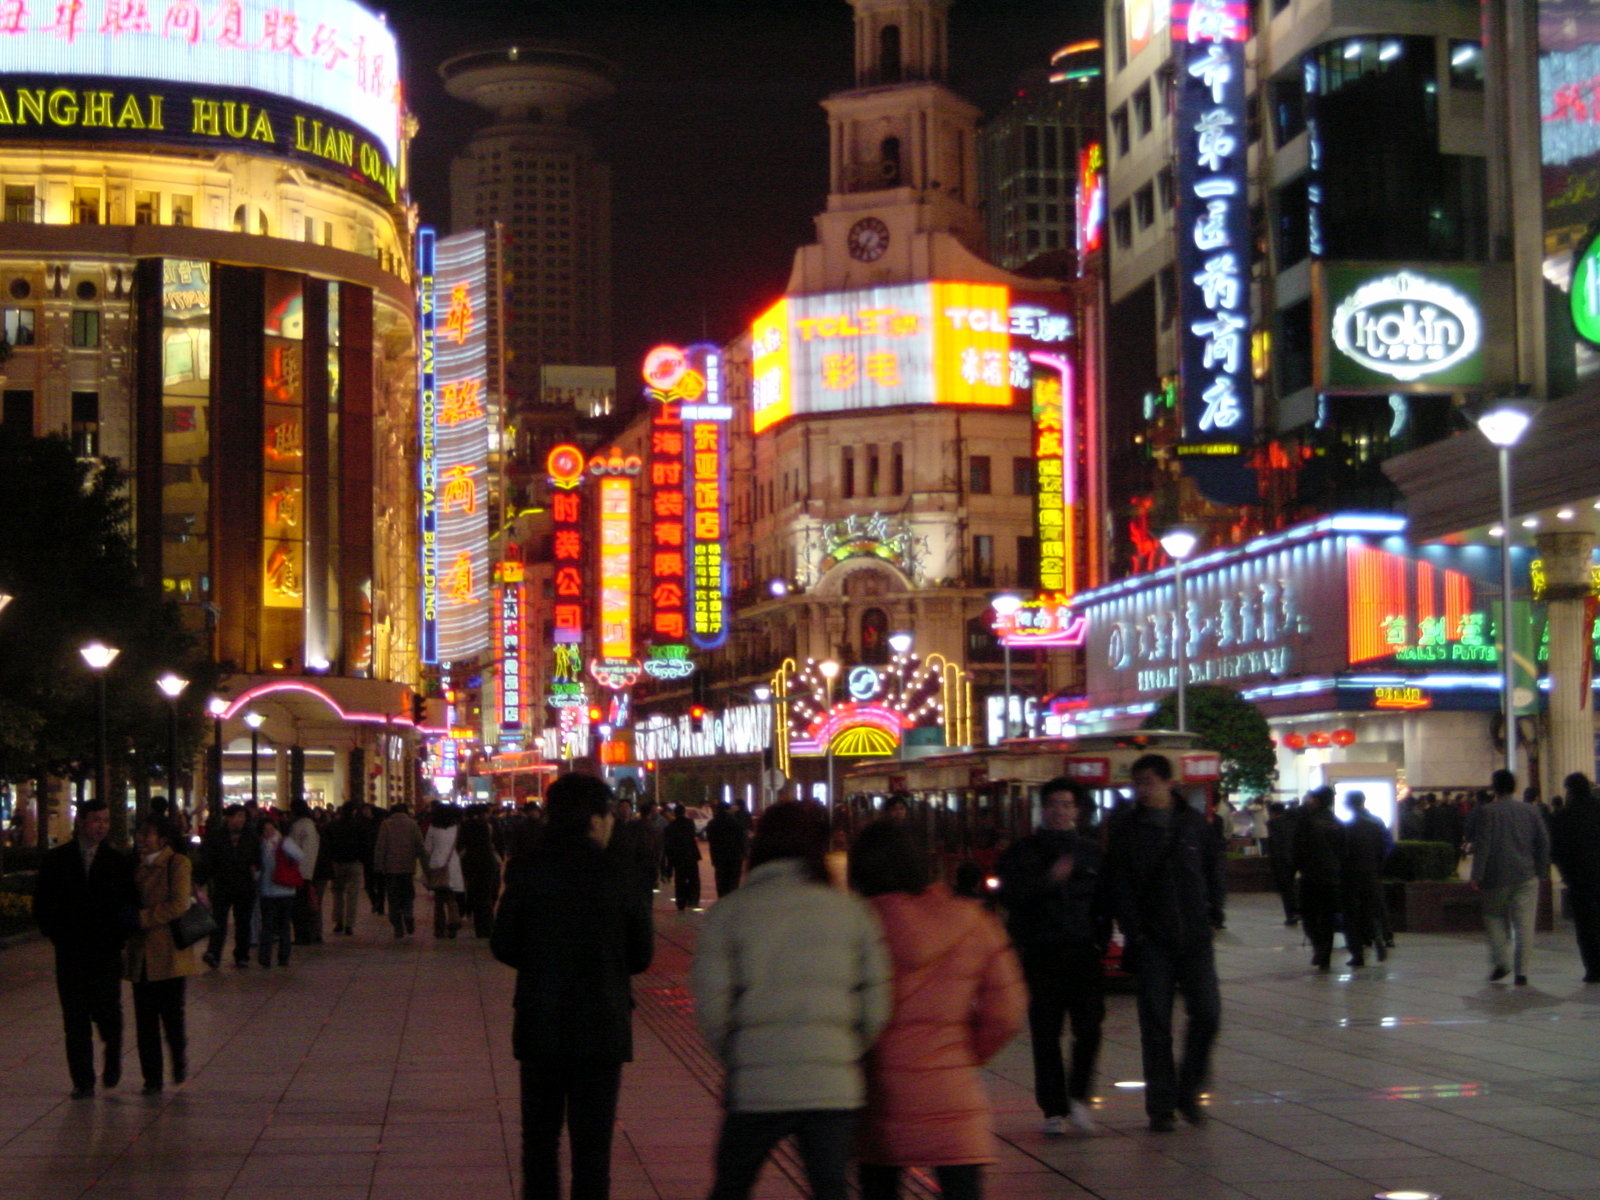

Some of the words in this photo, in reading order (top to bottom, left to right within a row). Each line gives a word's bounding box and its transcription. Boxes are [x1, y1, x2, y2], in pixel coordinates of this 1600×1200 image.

[191, 98, 275, 143] HUA
[295, 116, 354, 167] LIAN
[421, 277, 434, 314] HUA
[1355, 303, 1457, 357] Itokin
[422, 330, 434, 374] LIAN
[821, 349, 901, 391] 彩电
[694, 423, 720, 540] 东亚饭店
[653, 403, 683, 637] 上海时装有限公司
[423, 531, 436, 621] BUILDING
[554, 493, 581, 633] 时装公司
